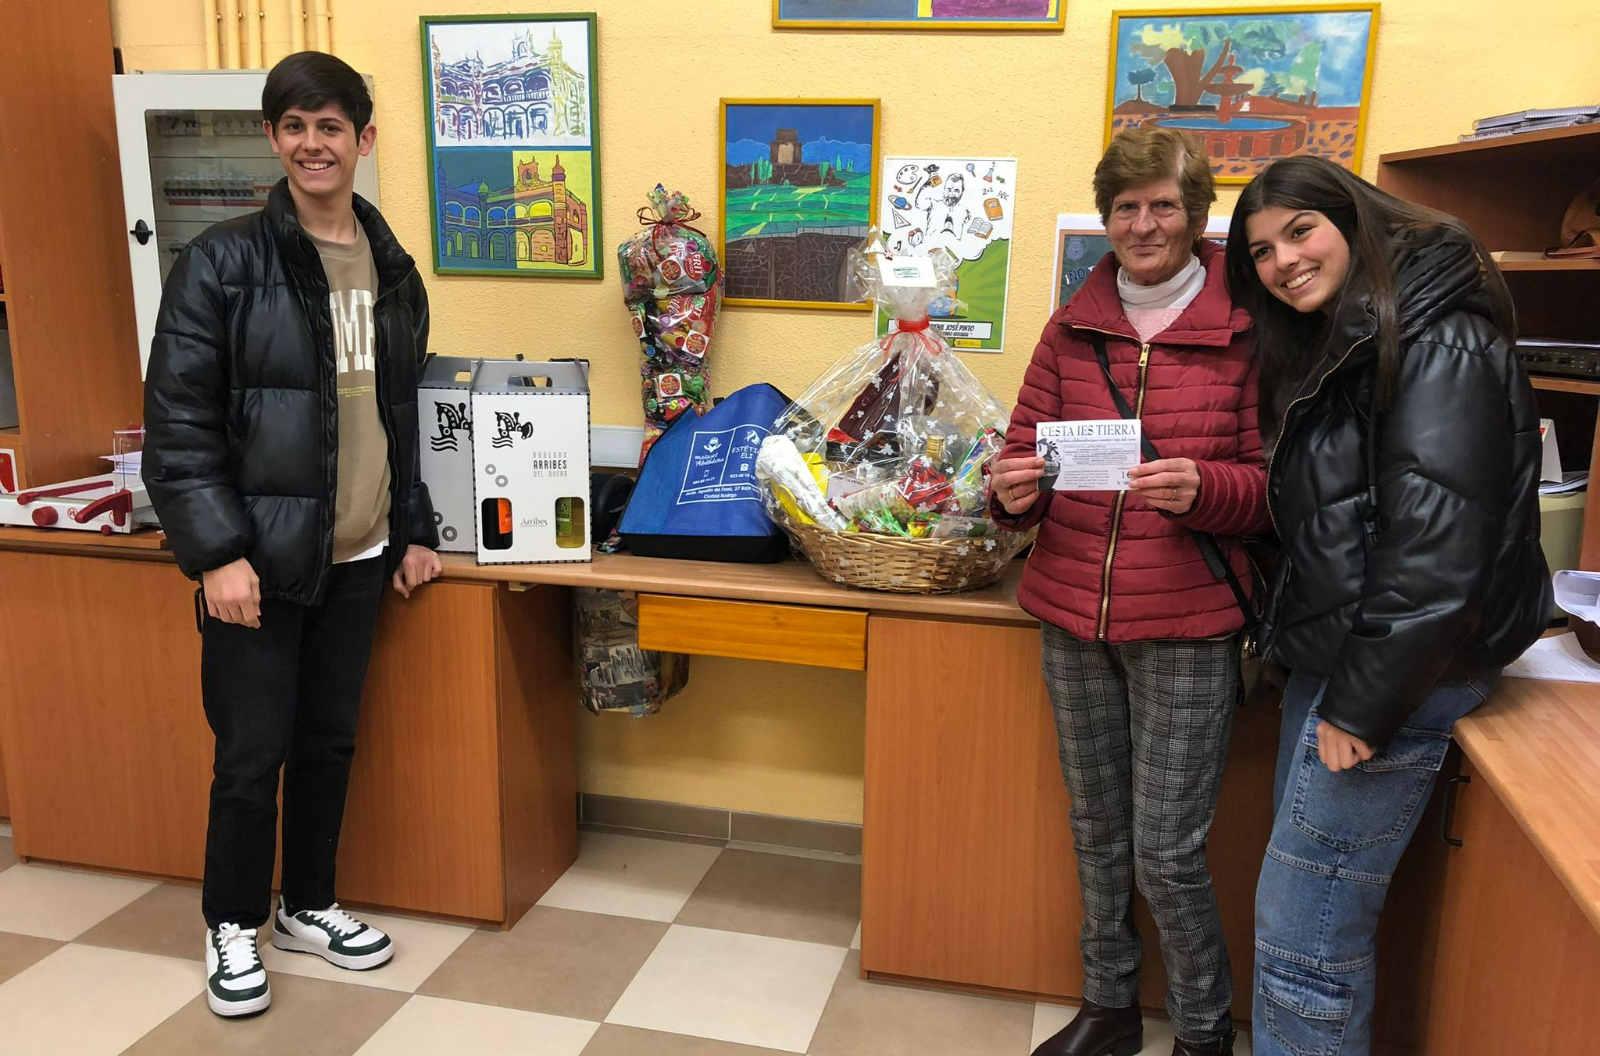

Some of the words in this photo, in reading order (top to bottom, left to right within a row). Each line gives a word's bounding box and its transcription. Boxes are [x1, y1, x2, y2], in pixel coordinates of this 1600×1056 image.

[692, 253, 703, 275] FRIT
[945, 322, 959, 331] JOSÉ
[958, 324, 975, 332] PINTO
[1040, 425, 1074, 437] CESTA
[1077, 424, 1094, 436] IES
[1096, 424, 1136, 436] TIERRA
[533, 459, 567, 470] ARRIBES
[520, 517, 549, 526] Arribes
